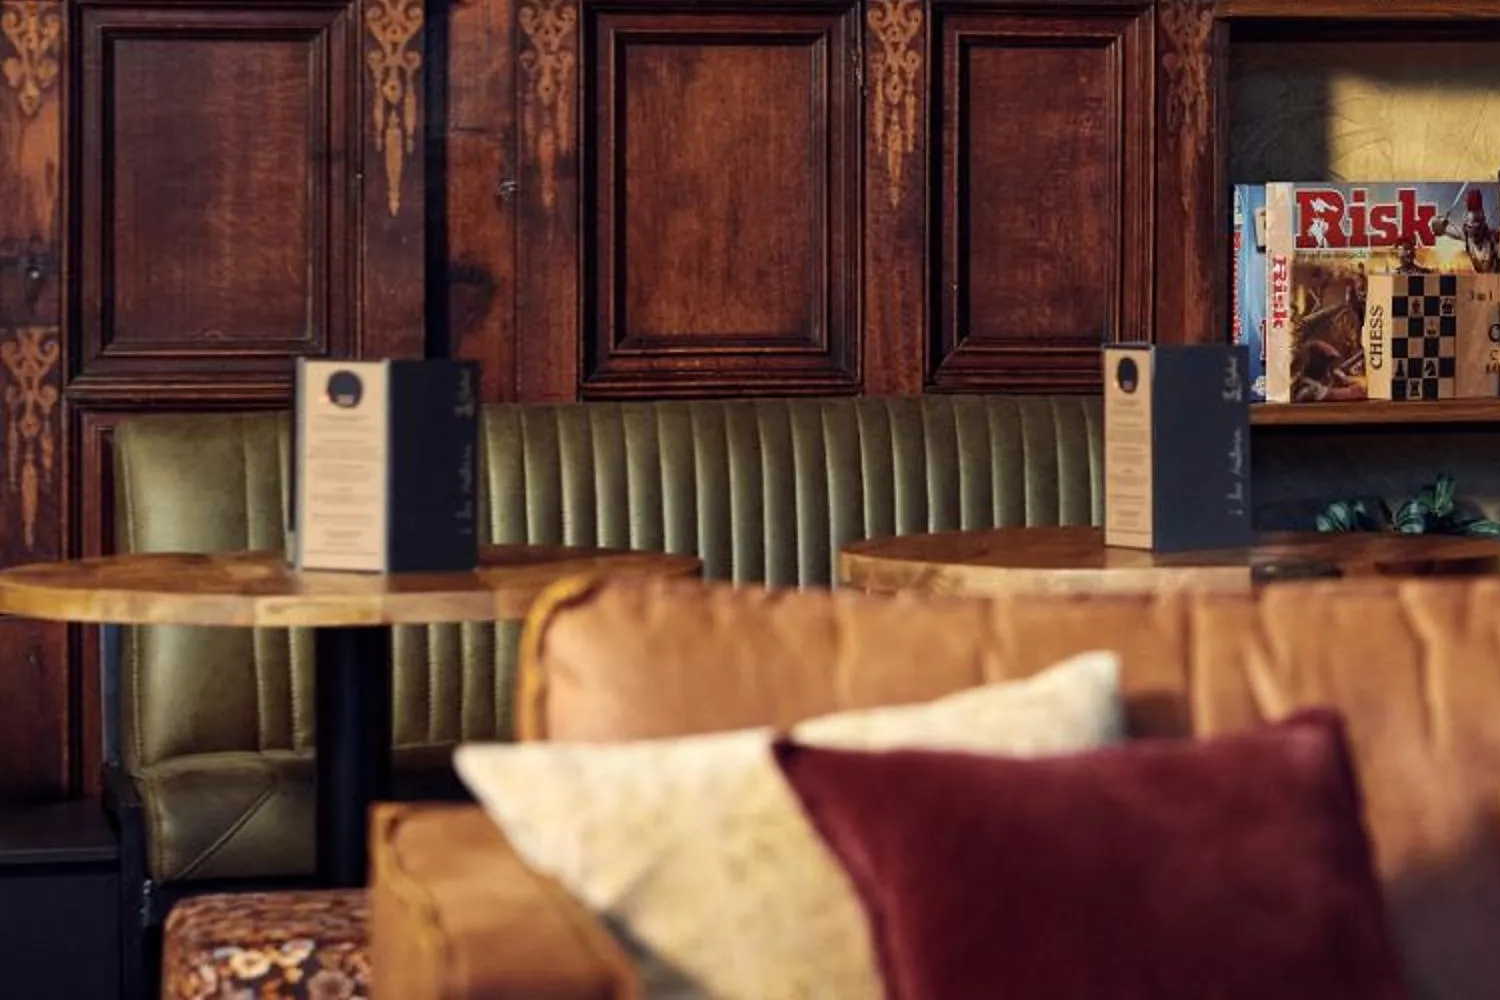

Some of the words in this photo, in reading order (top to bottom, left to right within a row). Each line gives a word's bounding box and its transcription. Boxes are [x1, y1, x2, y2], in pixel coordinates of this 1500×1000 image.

[1295, 187, 1438, 250] Risk
[1271, 256, 1287, 329] Risk
[1371, 304, 1384, 370] CHESS
